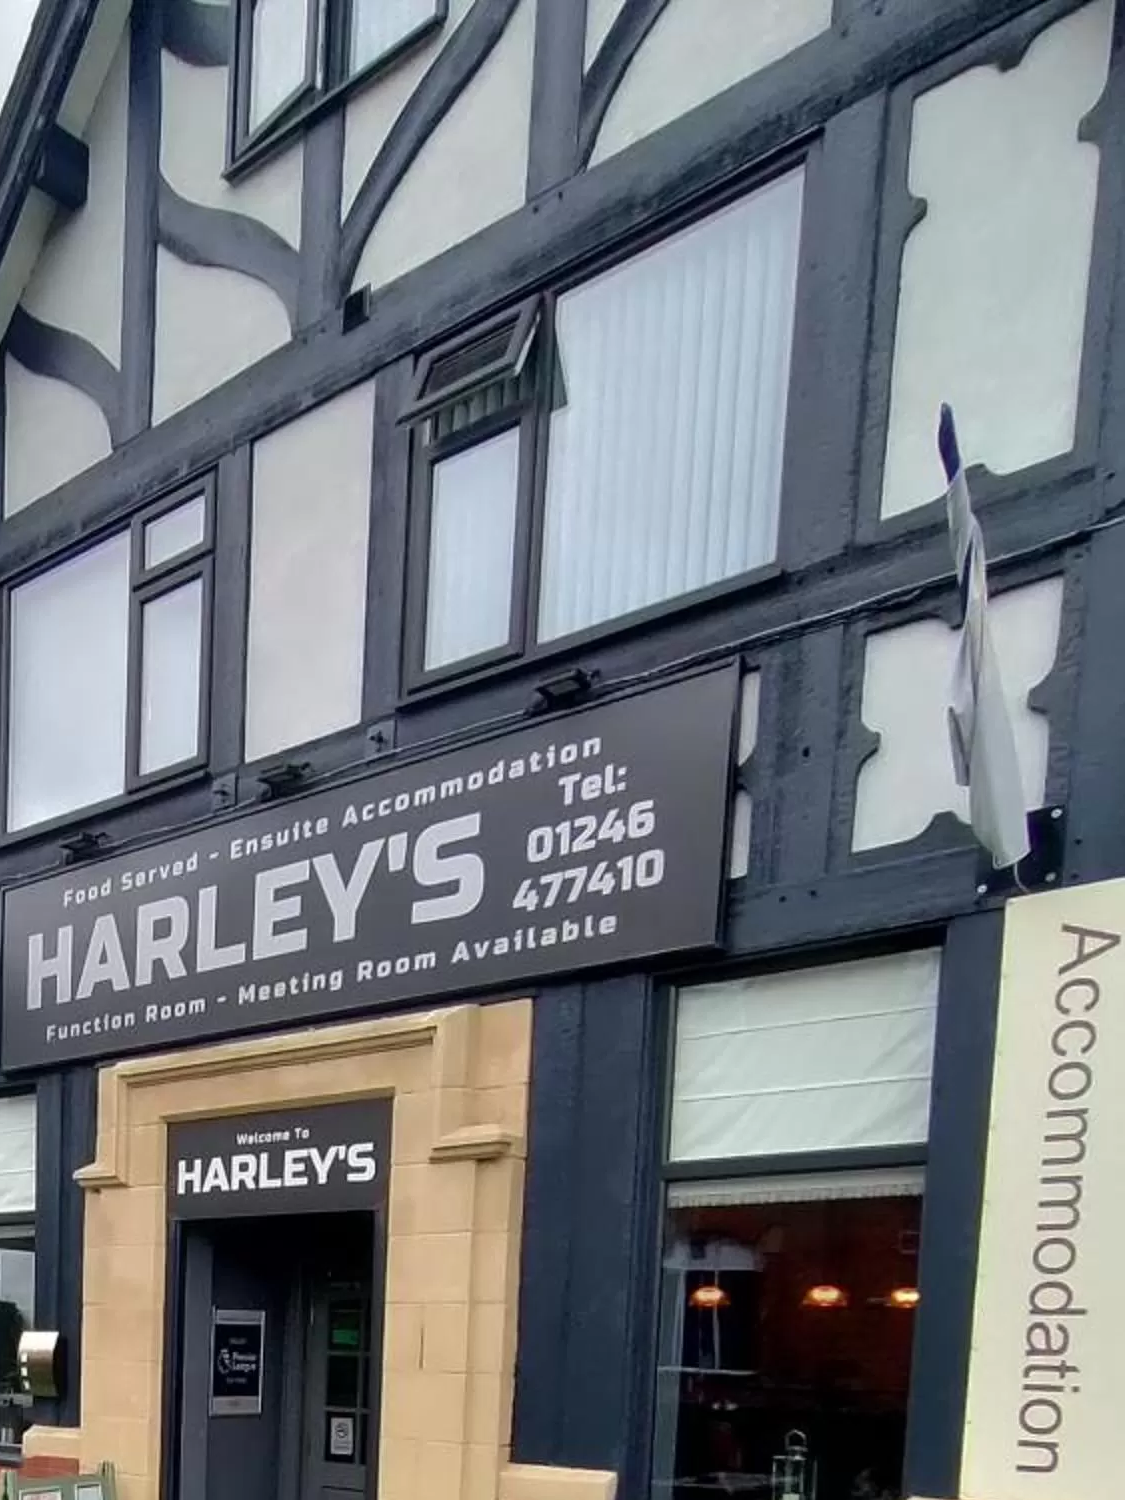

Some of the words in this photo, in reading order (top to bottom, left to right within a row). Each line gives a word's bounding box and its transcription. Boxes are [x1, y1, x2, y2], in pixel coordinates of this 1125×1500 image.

[557, 763, 628, 806] Tel:
[62, 876, 113, 909] Food
[120, 850, 199, 893] Served
[230, 817, 329, 861] Ensuite
[341, 737, 602, 828] Accommodation
[526, 799, 656, 863] 01246
[26, 811, 486, 1011] HARLEY'S
[512, 848, 666, 912] 477410
[46, 1012, 136, 1042] Function
[145, 998, 207, 1023] Room
[238, 969, 343, 1005] Meeting
[356, 951, 437, 982] Room
[450, 915, 618, 964] Available
[177, 1141, 376, 1194] HARLEY'S
[236, 1129, 291, 1145] Welcome
[294, 1126, 310, 1140] To
[1015, 923, 1122, 1474] Accommodation
